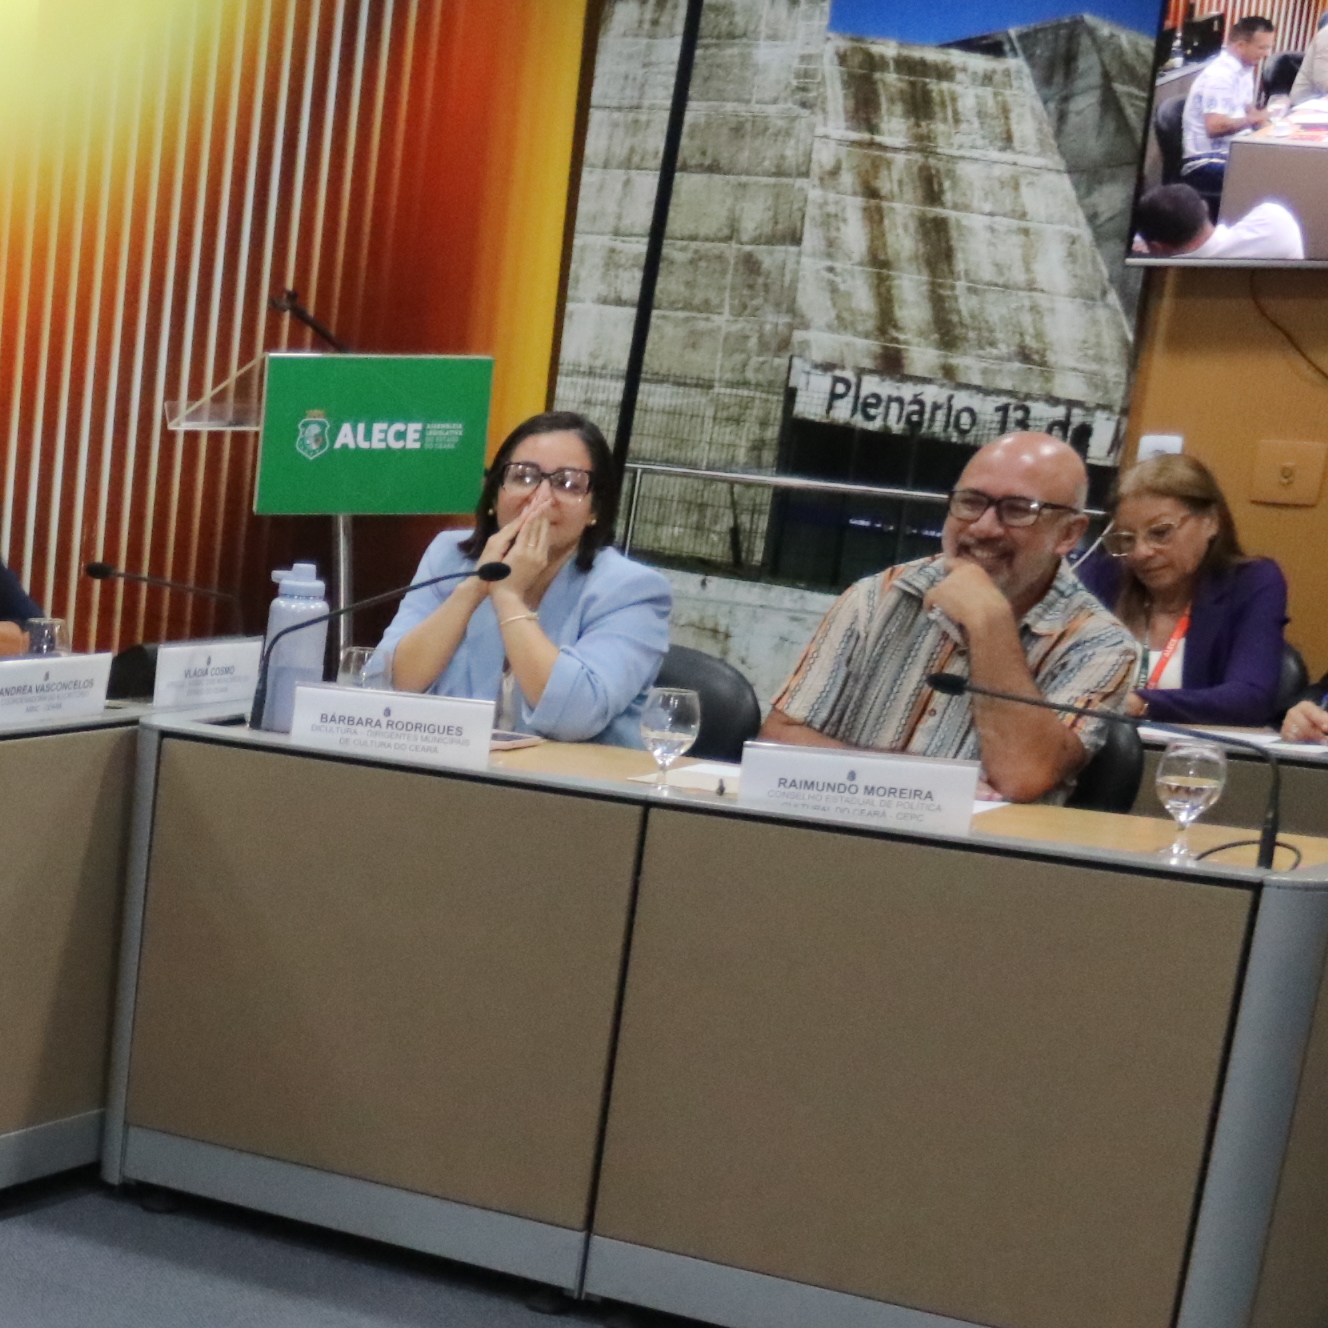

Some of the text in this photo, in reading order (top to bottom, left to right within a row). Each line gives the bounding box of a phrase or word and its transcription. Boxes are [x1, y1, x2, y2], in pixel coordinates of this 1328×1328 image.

[826, 374, 977, 435] Plenário
[995, 403, 1030, 436] 13
[333, 422, 423, 449] ALECE
[35, 678, 94, 694] VASCONCELOS
[320, 712, 463, 736] BÁRBARA RODRIGUES
[339, 737, 350, 745] DE
[353, 739, 392, 750] CULTURA
[394, 742, 407, 750] DO
[367, 729, 418, 742] DIRIGENTES
[767, 789, 823, 801] CONSELHO
[824, 795, 876, 807] ESTADUAL
[879, 800, 893, 809] DE
[777, 777, 934, 801] RAIMUNDO MOREIRA
